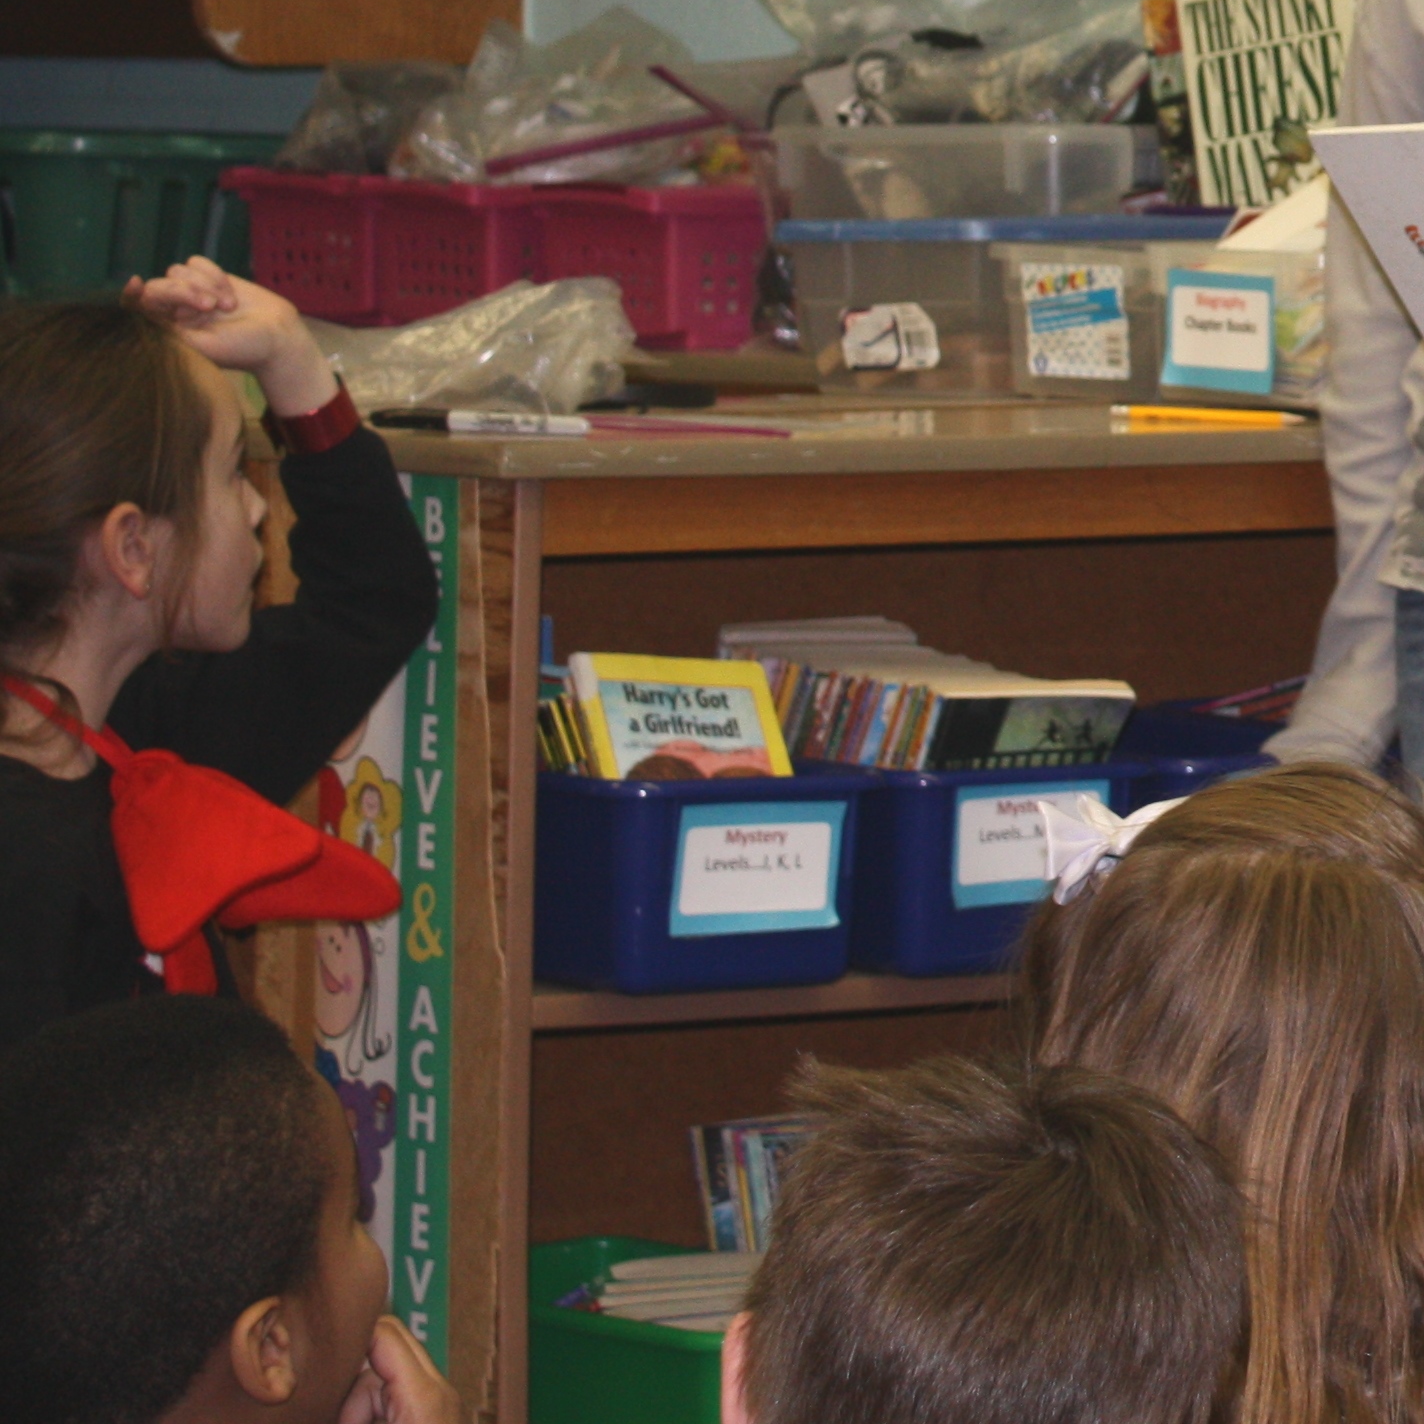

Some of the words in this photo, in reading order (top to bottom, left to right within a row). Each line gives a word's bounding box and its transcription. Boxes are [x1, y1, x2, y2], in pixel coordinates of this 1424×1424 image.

[1196, 31, 1344, 142] CHEESE
[413, 496, 447, 871] BLIEVE
[622, 682, 692, 711] Harry's
[694, 688, 730, 710] Got
[629, 716, 641, 733] a
[644, 712, 742, 739] Girlfriend!
[996, 799, 1040, 818] Myste
[725, 829, 789, 848] Mystery
[405, 882, 445, 963] &
